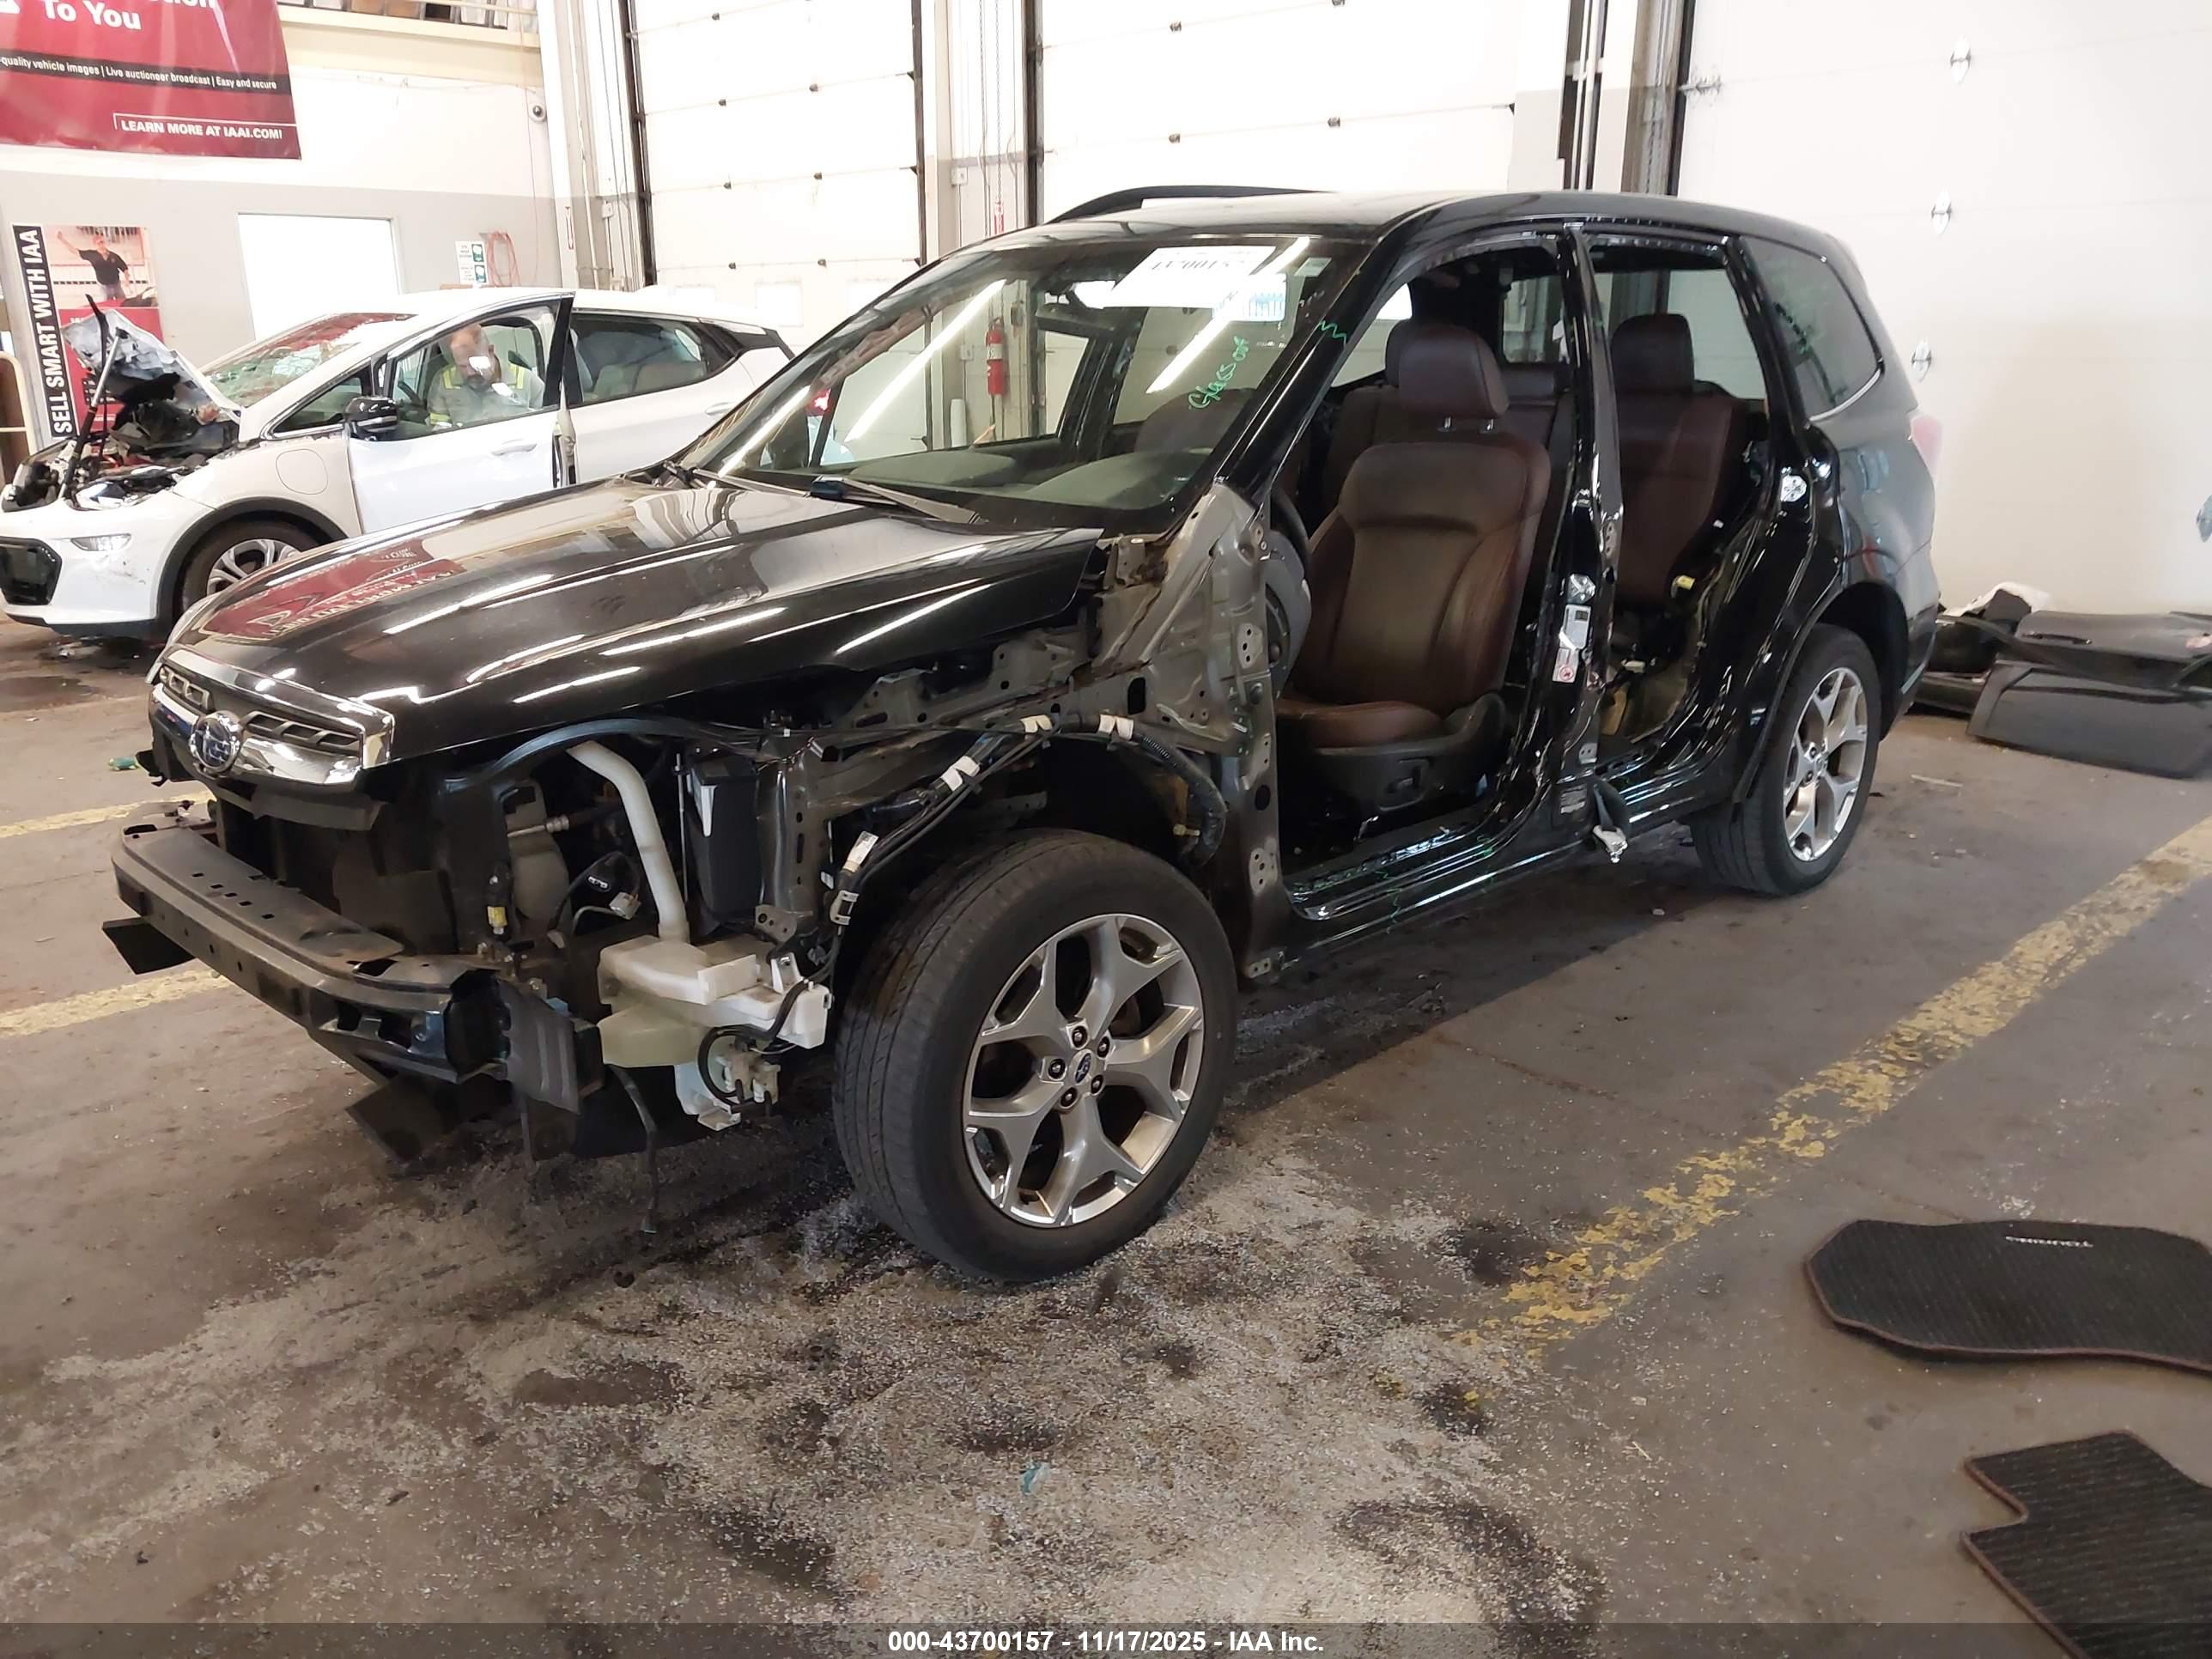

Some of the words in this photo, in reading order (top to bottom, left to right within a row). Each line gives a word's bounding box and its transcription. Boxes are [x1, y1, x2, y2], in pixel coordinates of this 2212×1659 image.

[43, 0, 77, 21] To
[82, 0, 142, 30] You
[33, 60, 65, 71] vehicle
[67, 62, 100, 76] images
[106, 66, 124, 76] Live
[125, 70, 169, 82] auctioneer
[170, 72, 211, 85] broadcast
[216, 76, 235, 88] Easy
[235, 79, 251, 88] and
[252, 80, 277, 89] secure
[121, 119, 166, 133] LEARN
[167, 123, 204, 136] MORE
[205, 125, 222, 137] AT
[19, 229, 43, 263] IAA
[27, 269, 52, 318] WITH
[36, 321, 65, 387] SMART
[49, 391, 72, 434] SELL
